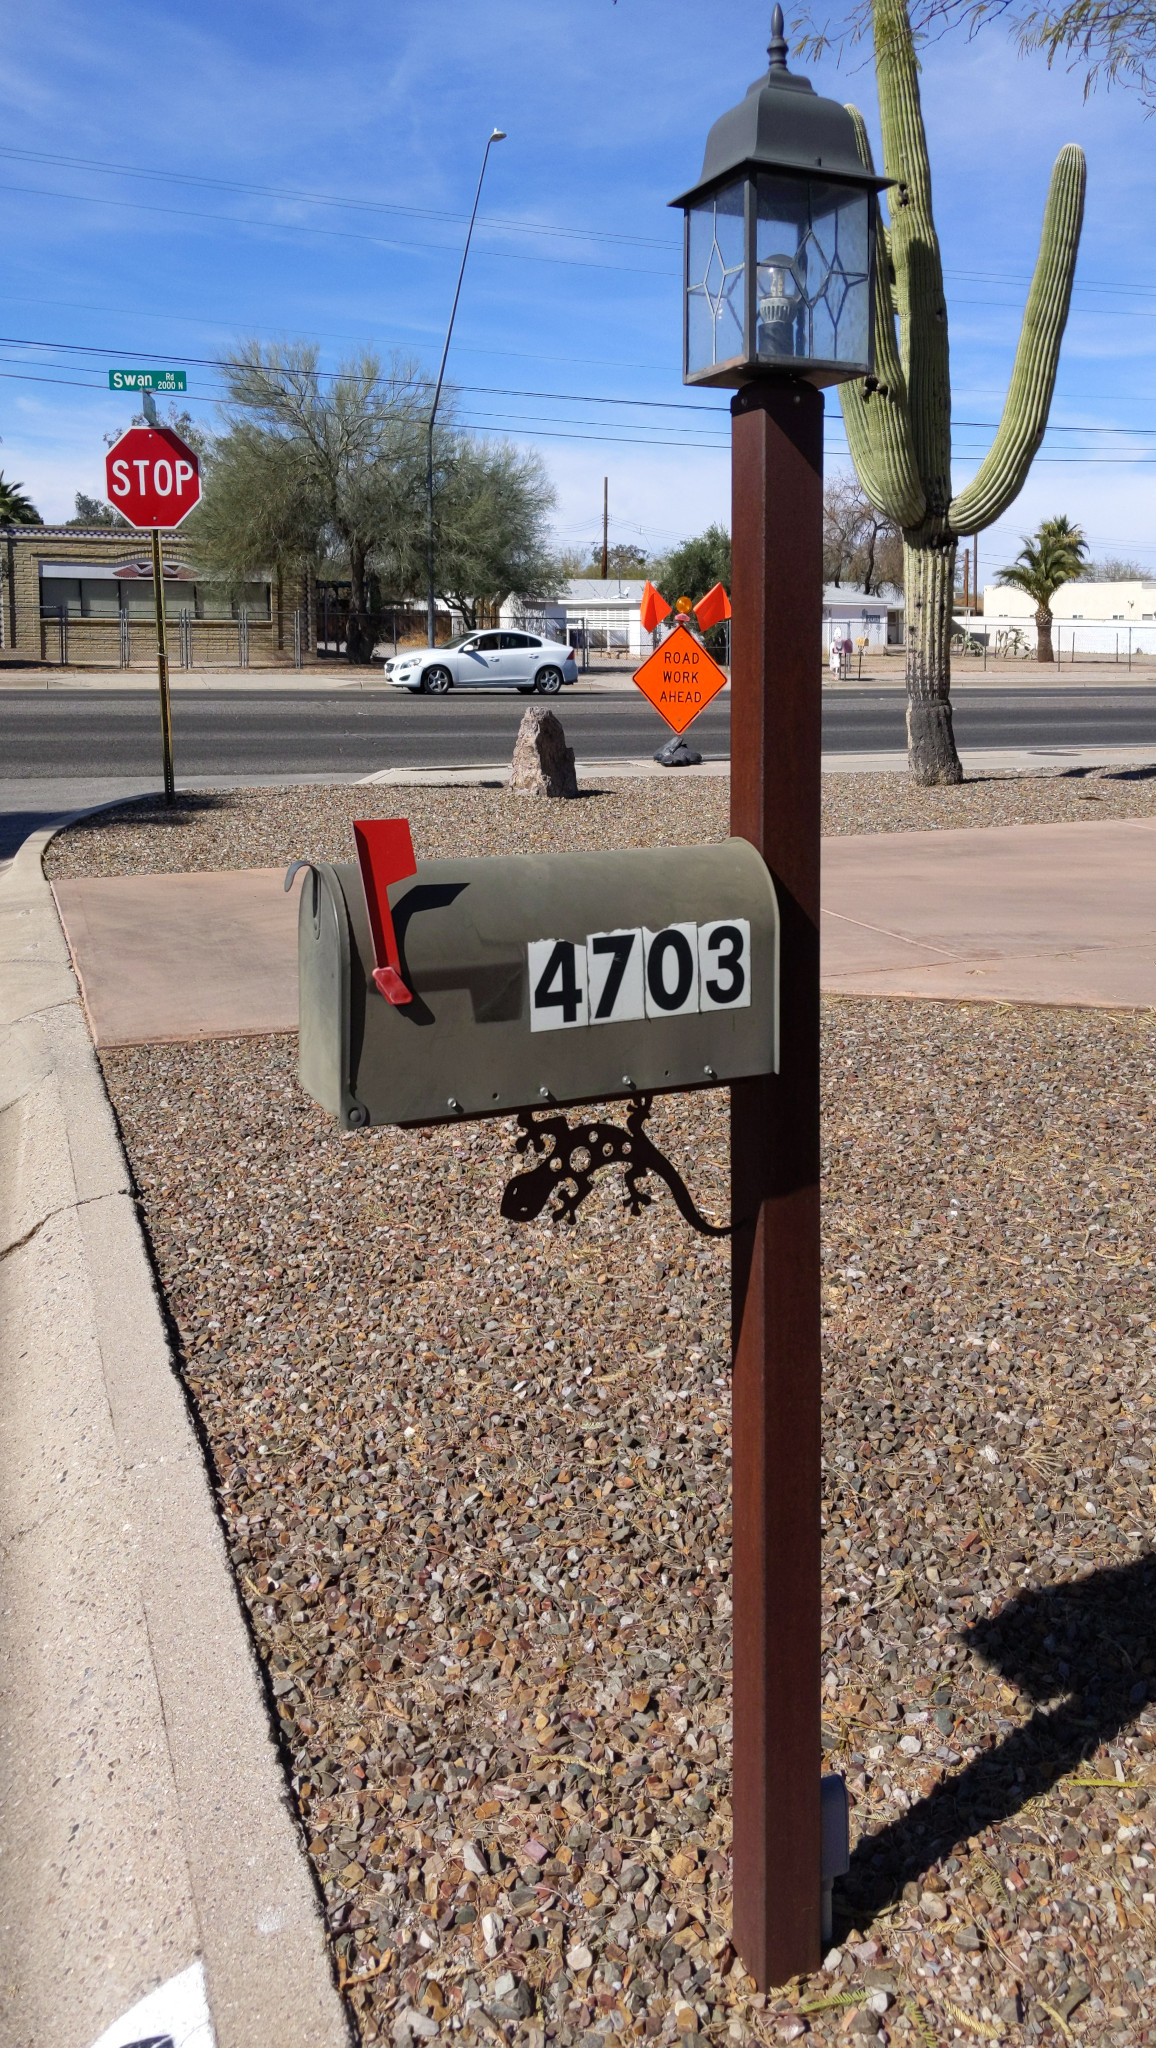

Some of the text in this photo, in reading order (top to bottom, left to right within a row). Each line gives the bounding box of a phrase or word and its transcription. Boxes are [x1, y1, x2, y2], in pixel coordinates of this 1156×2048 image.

[113, 372, 175, 388] Swan Rd
[157, 381, 184, 390] 2000 N
[112, 459, 194, 497] STOP
[664, 651, 700, 665] ROAD
[663, 671, 699, 684] WORK
[660, 691, 702, 703] AHEAD
[534, 925, 746, 1023] 4703
